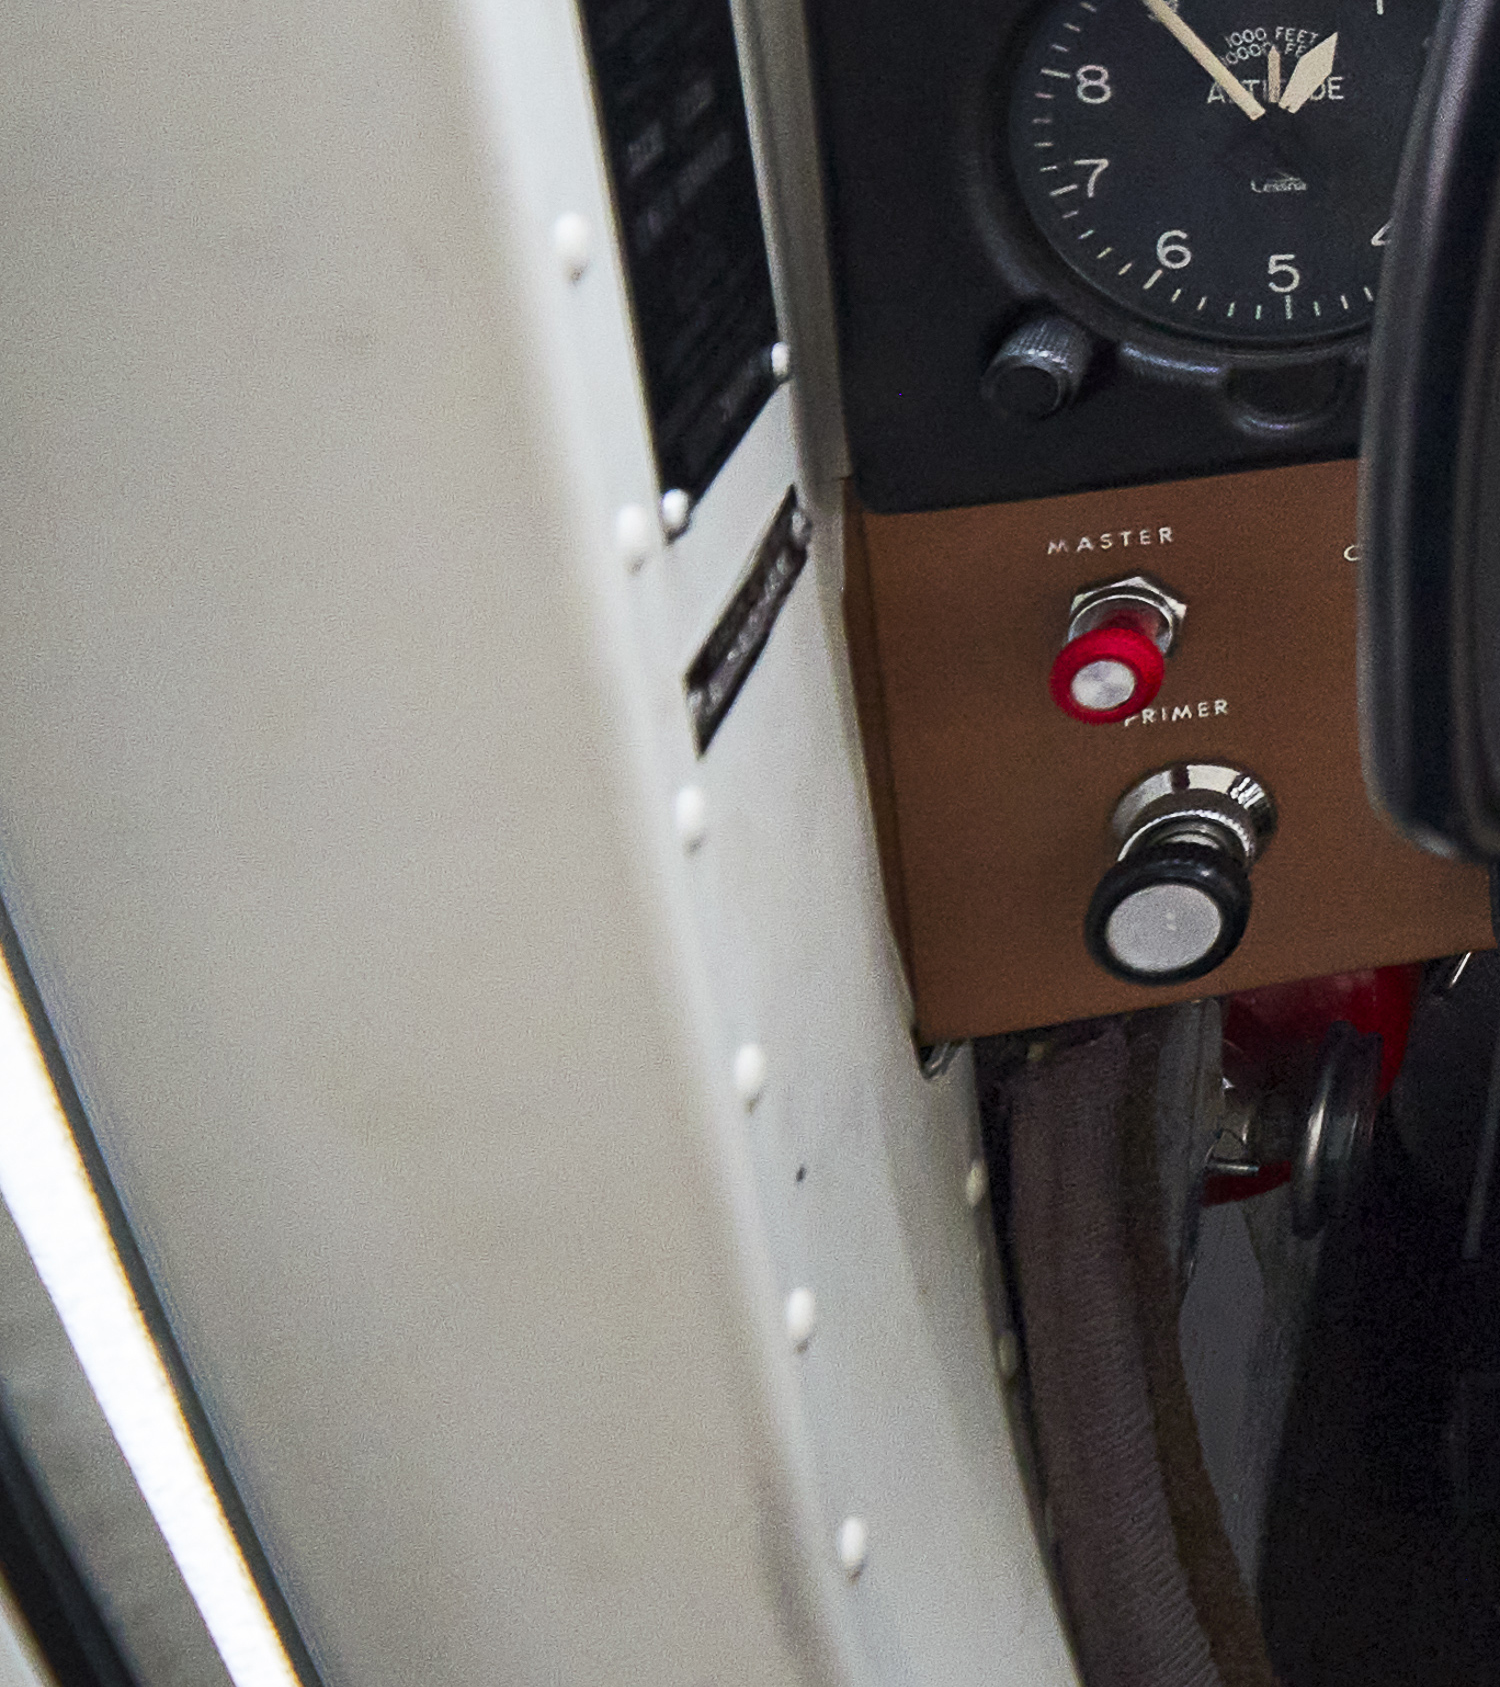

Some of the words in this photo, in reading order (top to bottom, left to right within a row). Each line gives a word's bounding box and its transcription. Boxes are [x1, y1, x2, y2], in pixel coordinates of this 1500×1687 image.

[1225, 27, 1267, 48] 1000
[1275, 26, 1319, 45] FEET
[1075, 65, 1112, 104] 8
[1075, 158, 1109, 198] 7
[1157, 231, 1192, 270] 6
[1268, 254, 1300, 293] 5
[1047, 527, 1173, 554] MASTER
